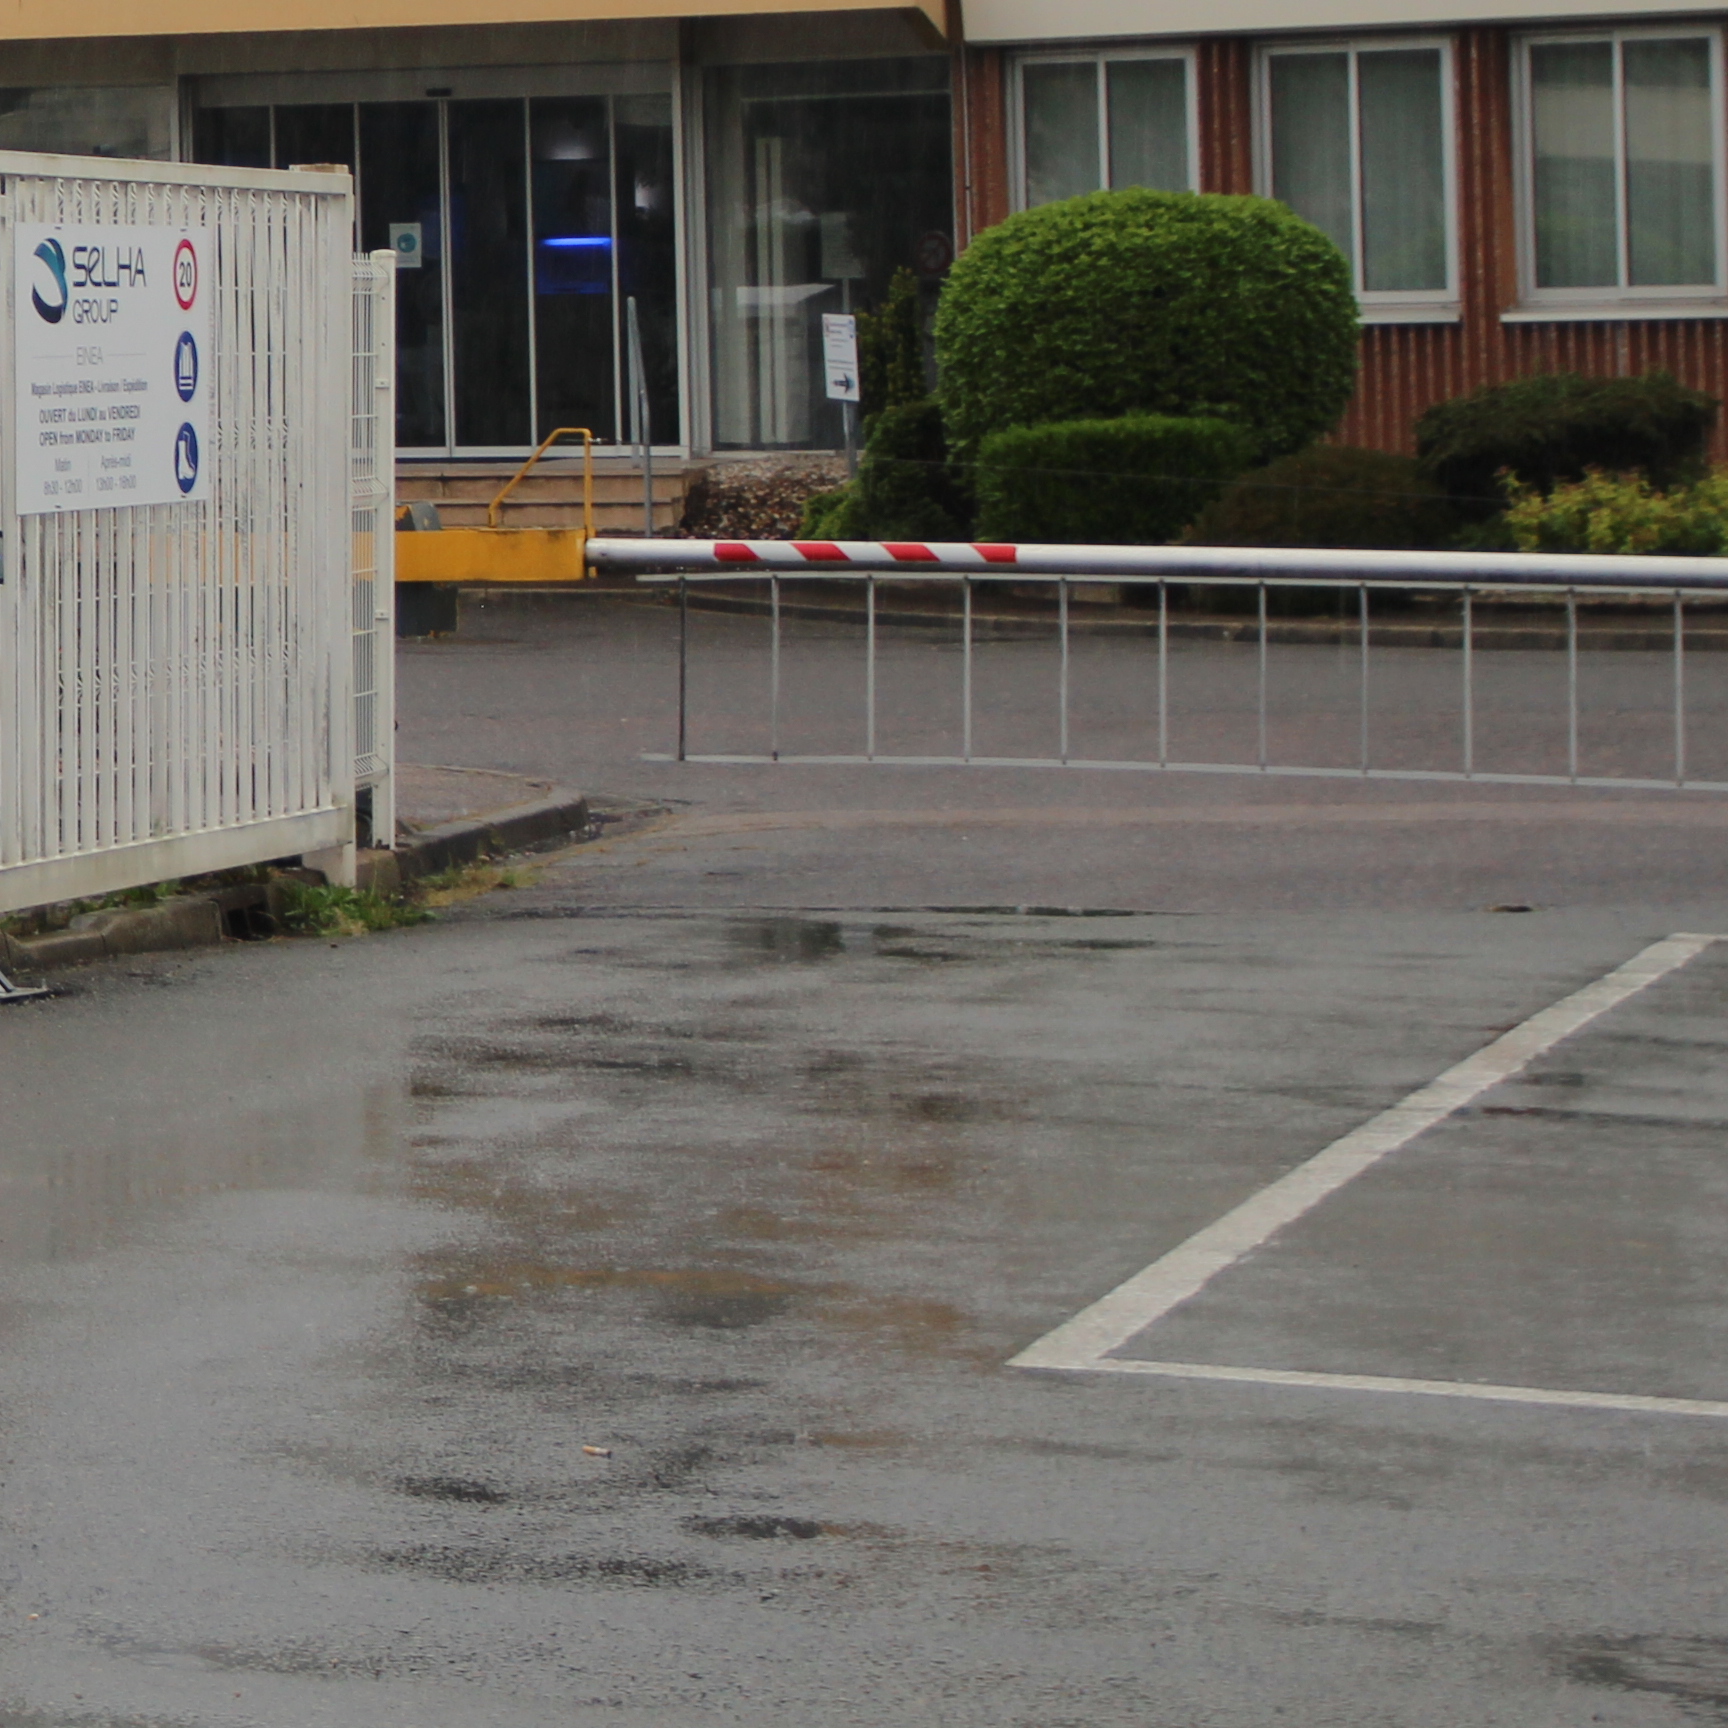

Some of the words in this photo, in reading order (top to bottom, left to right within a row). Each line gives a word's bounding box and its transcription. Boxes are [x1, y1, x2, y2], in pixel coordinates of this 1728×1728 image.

[179, 261, 192, 287] 20
[72, 299, 118, 323] GROUP
[39, 409, 67, 424] OUVERT
[108, 405, 141, 420] VENDREDI
[39, 431, 58, 446] OPEN
[112, 427, 136, 441] FRIDAY
